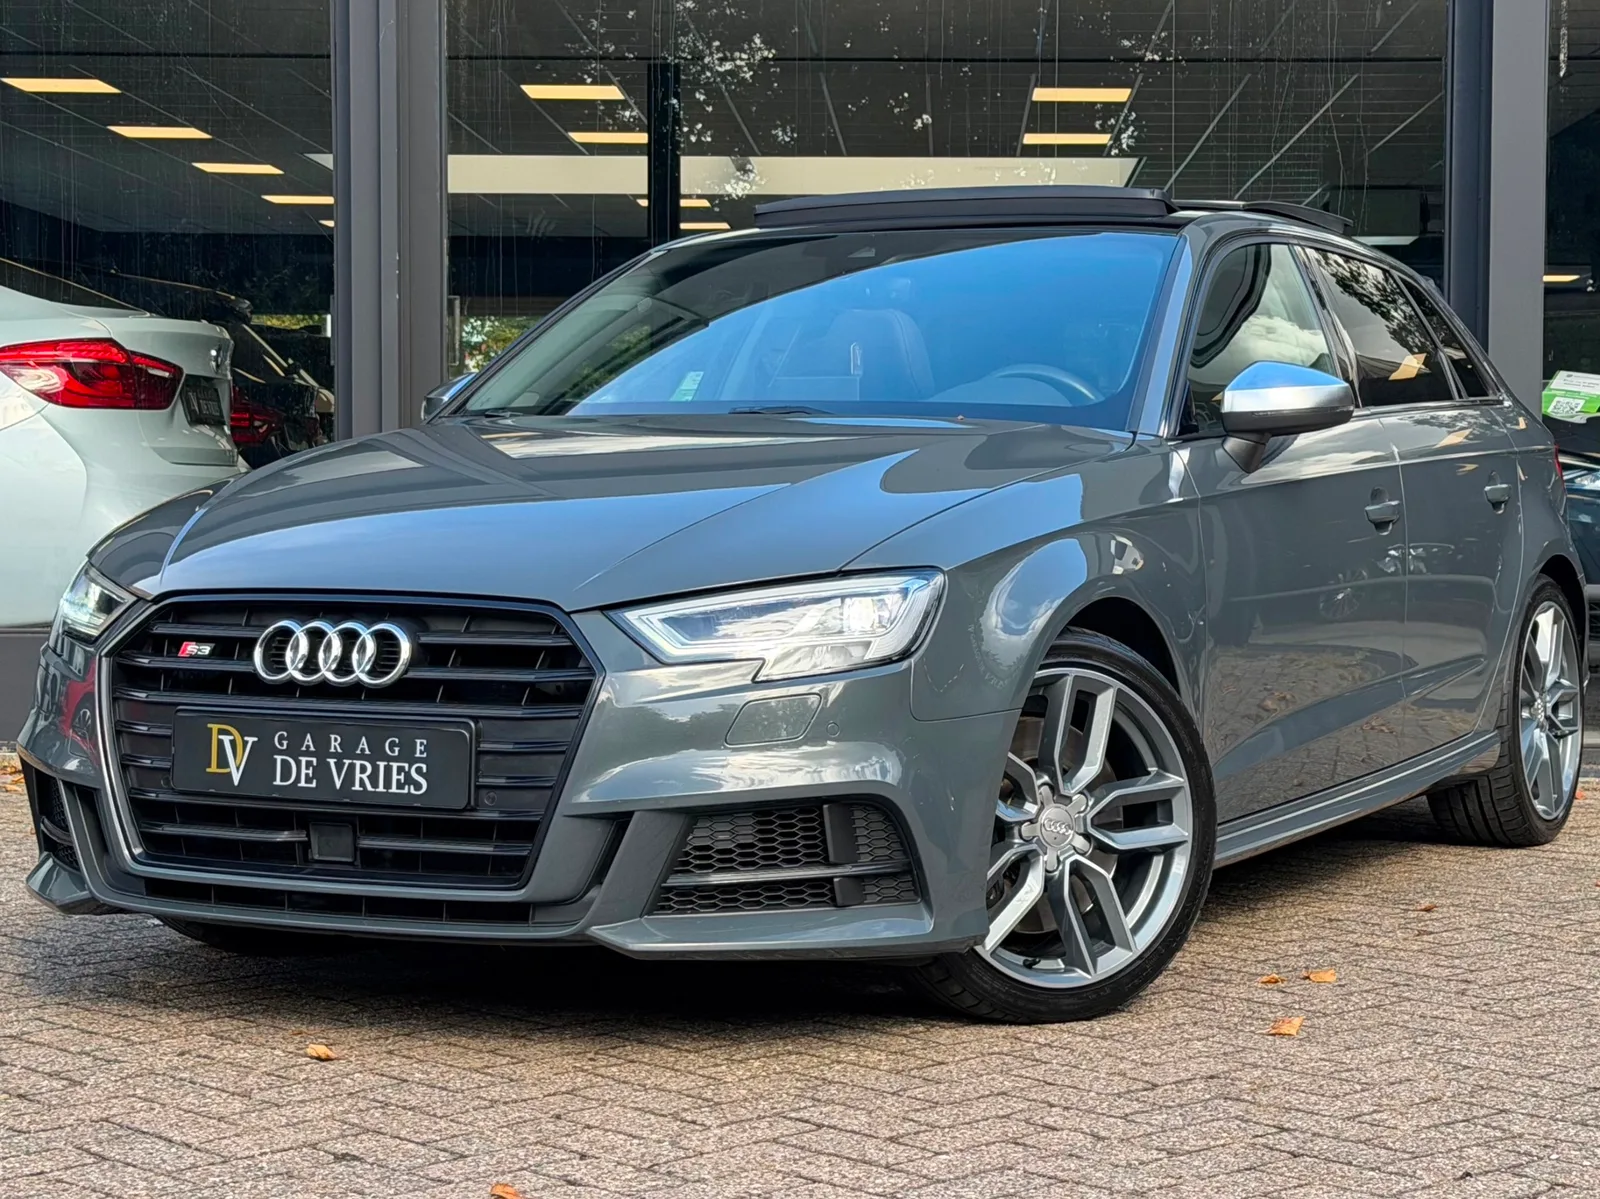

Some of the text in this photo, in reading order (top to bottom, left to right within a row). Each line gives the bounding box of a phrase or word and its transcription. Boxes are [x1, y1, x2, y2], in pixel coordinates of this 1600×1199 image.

[185, 644, 211, 656] S3
[274, 731, 427, 757] GARAGE
[273, 755, 428, 795] DE VRIES
